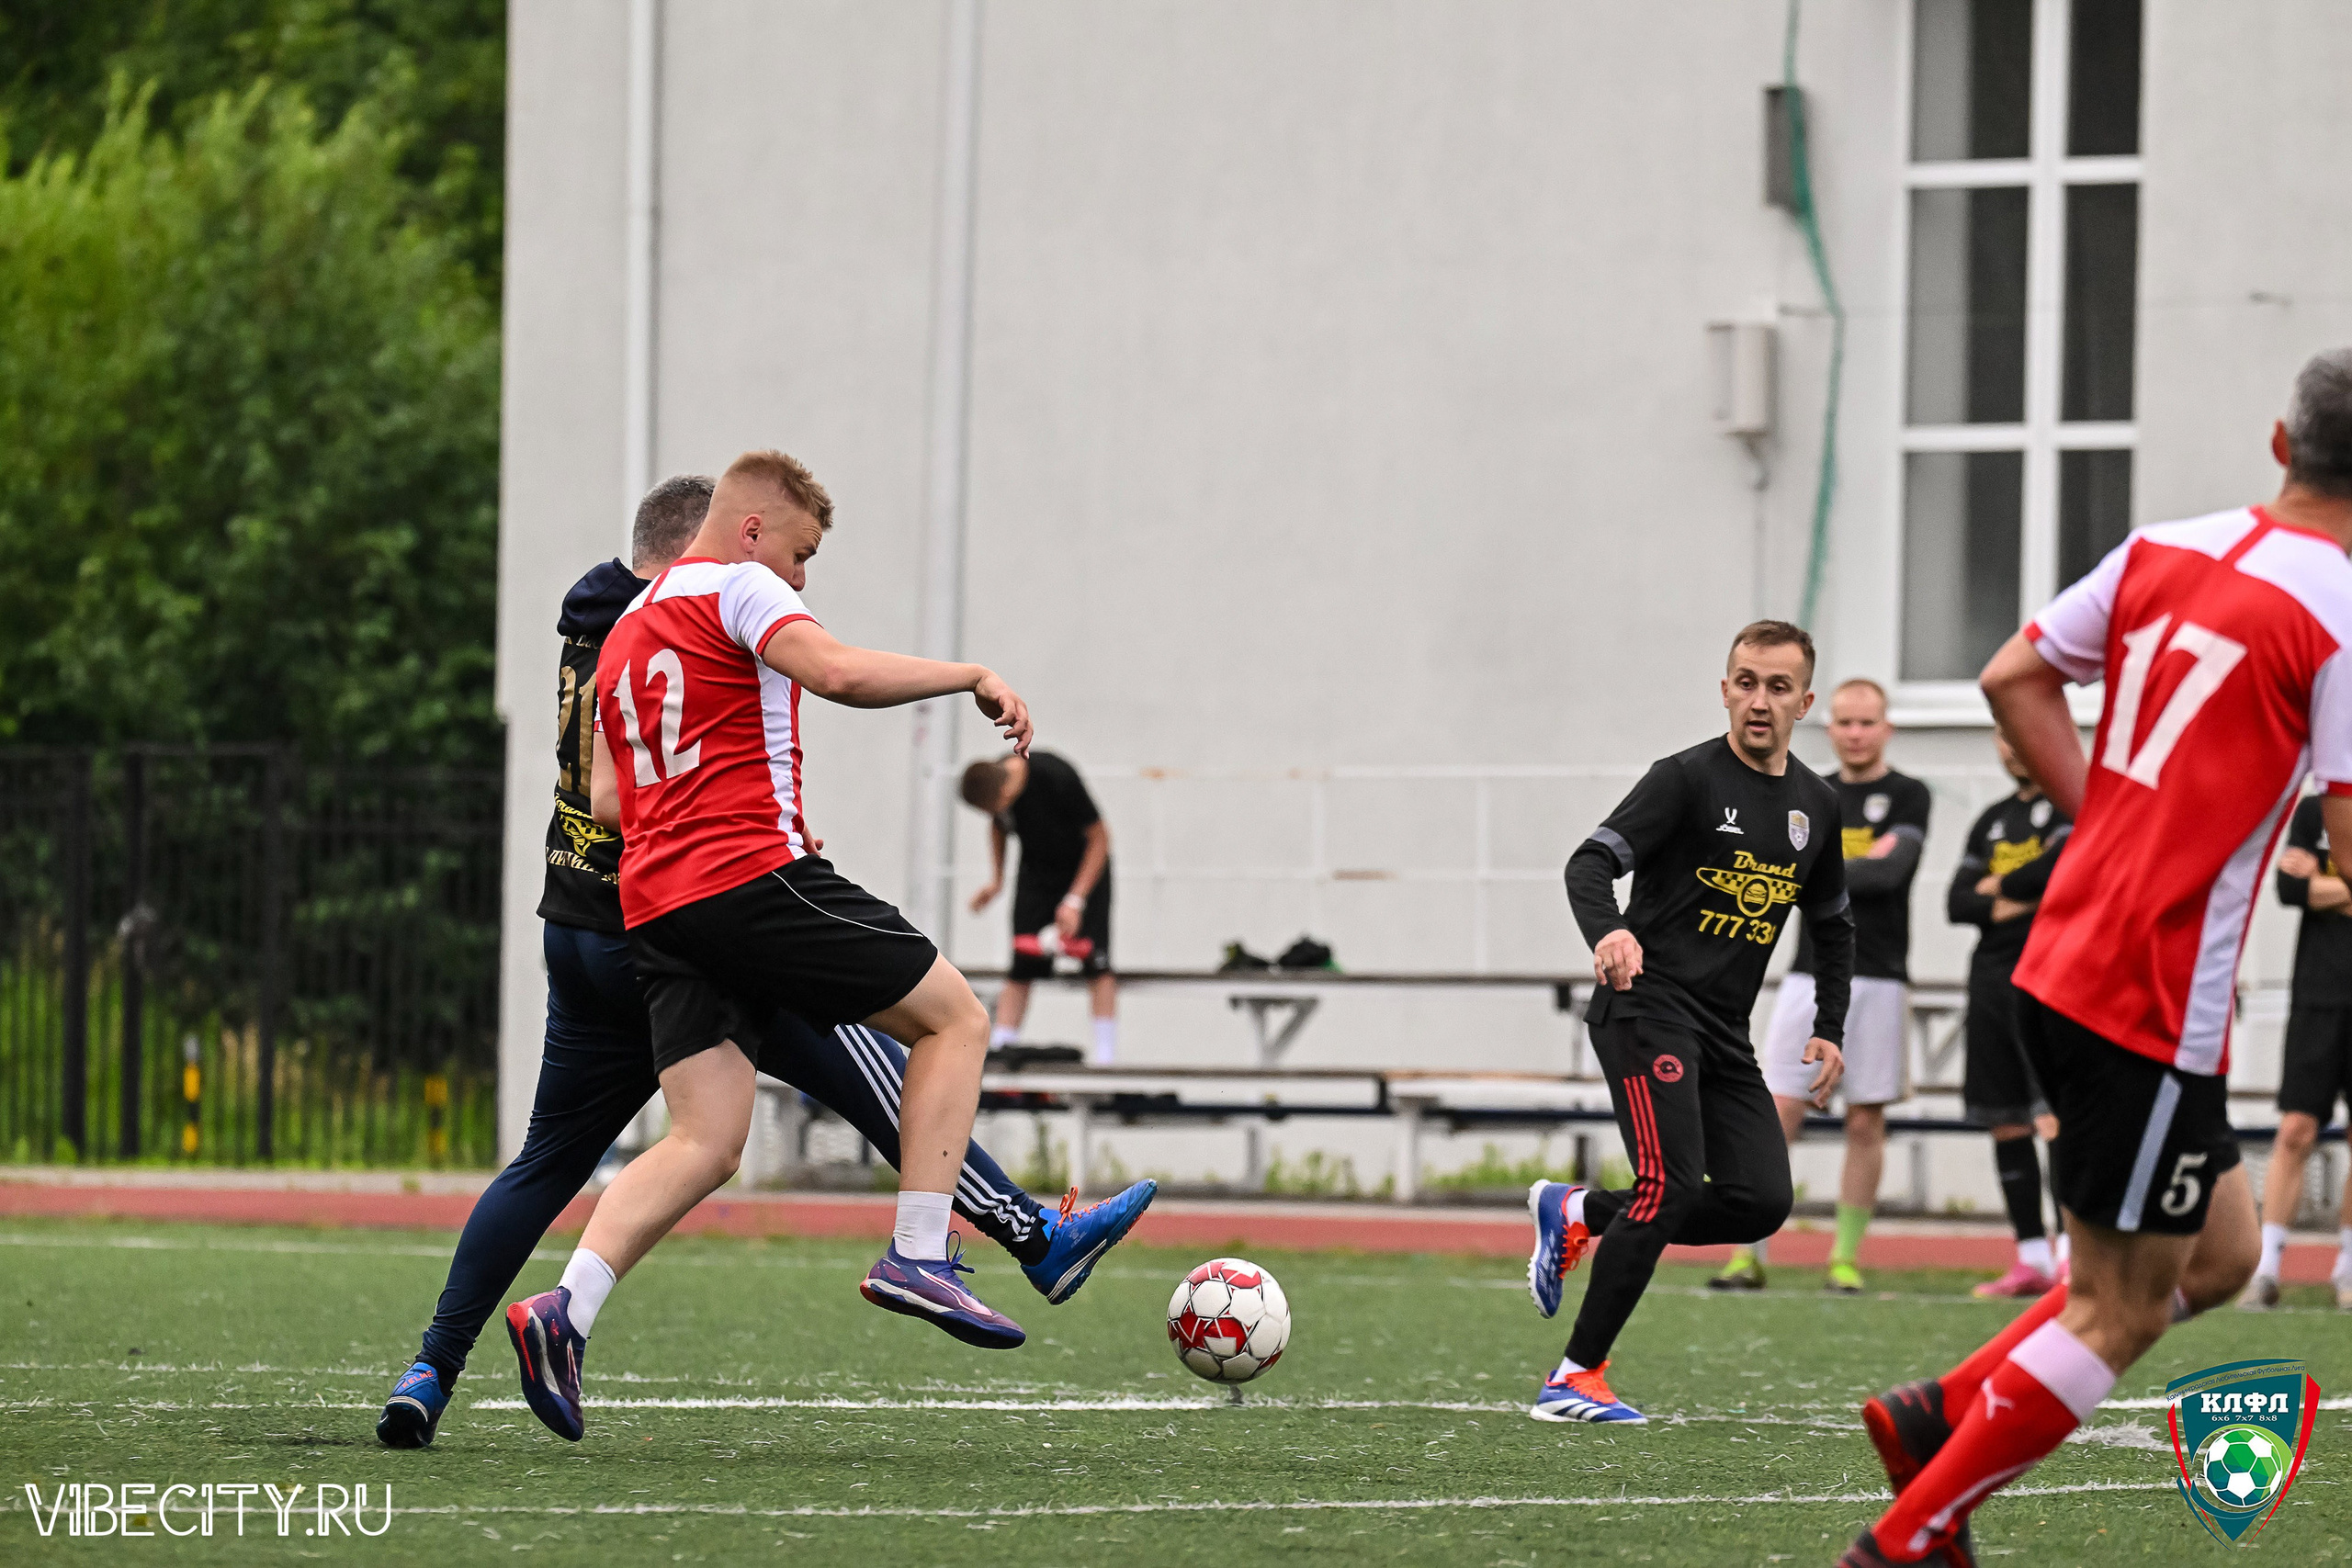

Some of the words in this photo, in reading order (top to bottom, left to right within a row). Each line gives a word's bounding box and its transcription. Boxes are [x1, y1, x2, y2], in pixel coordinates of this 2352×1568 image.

[613, 649, 701, 788] 12
[2100, 611, 2249, 791] 17
[1734, 850, 1797, 878] Brand
[1698, 908, 1745, 939] 777
[2160, 1151, 2208, 1217] 5
